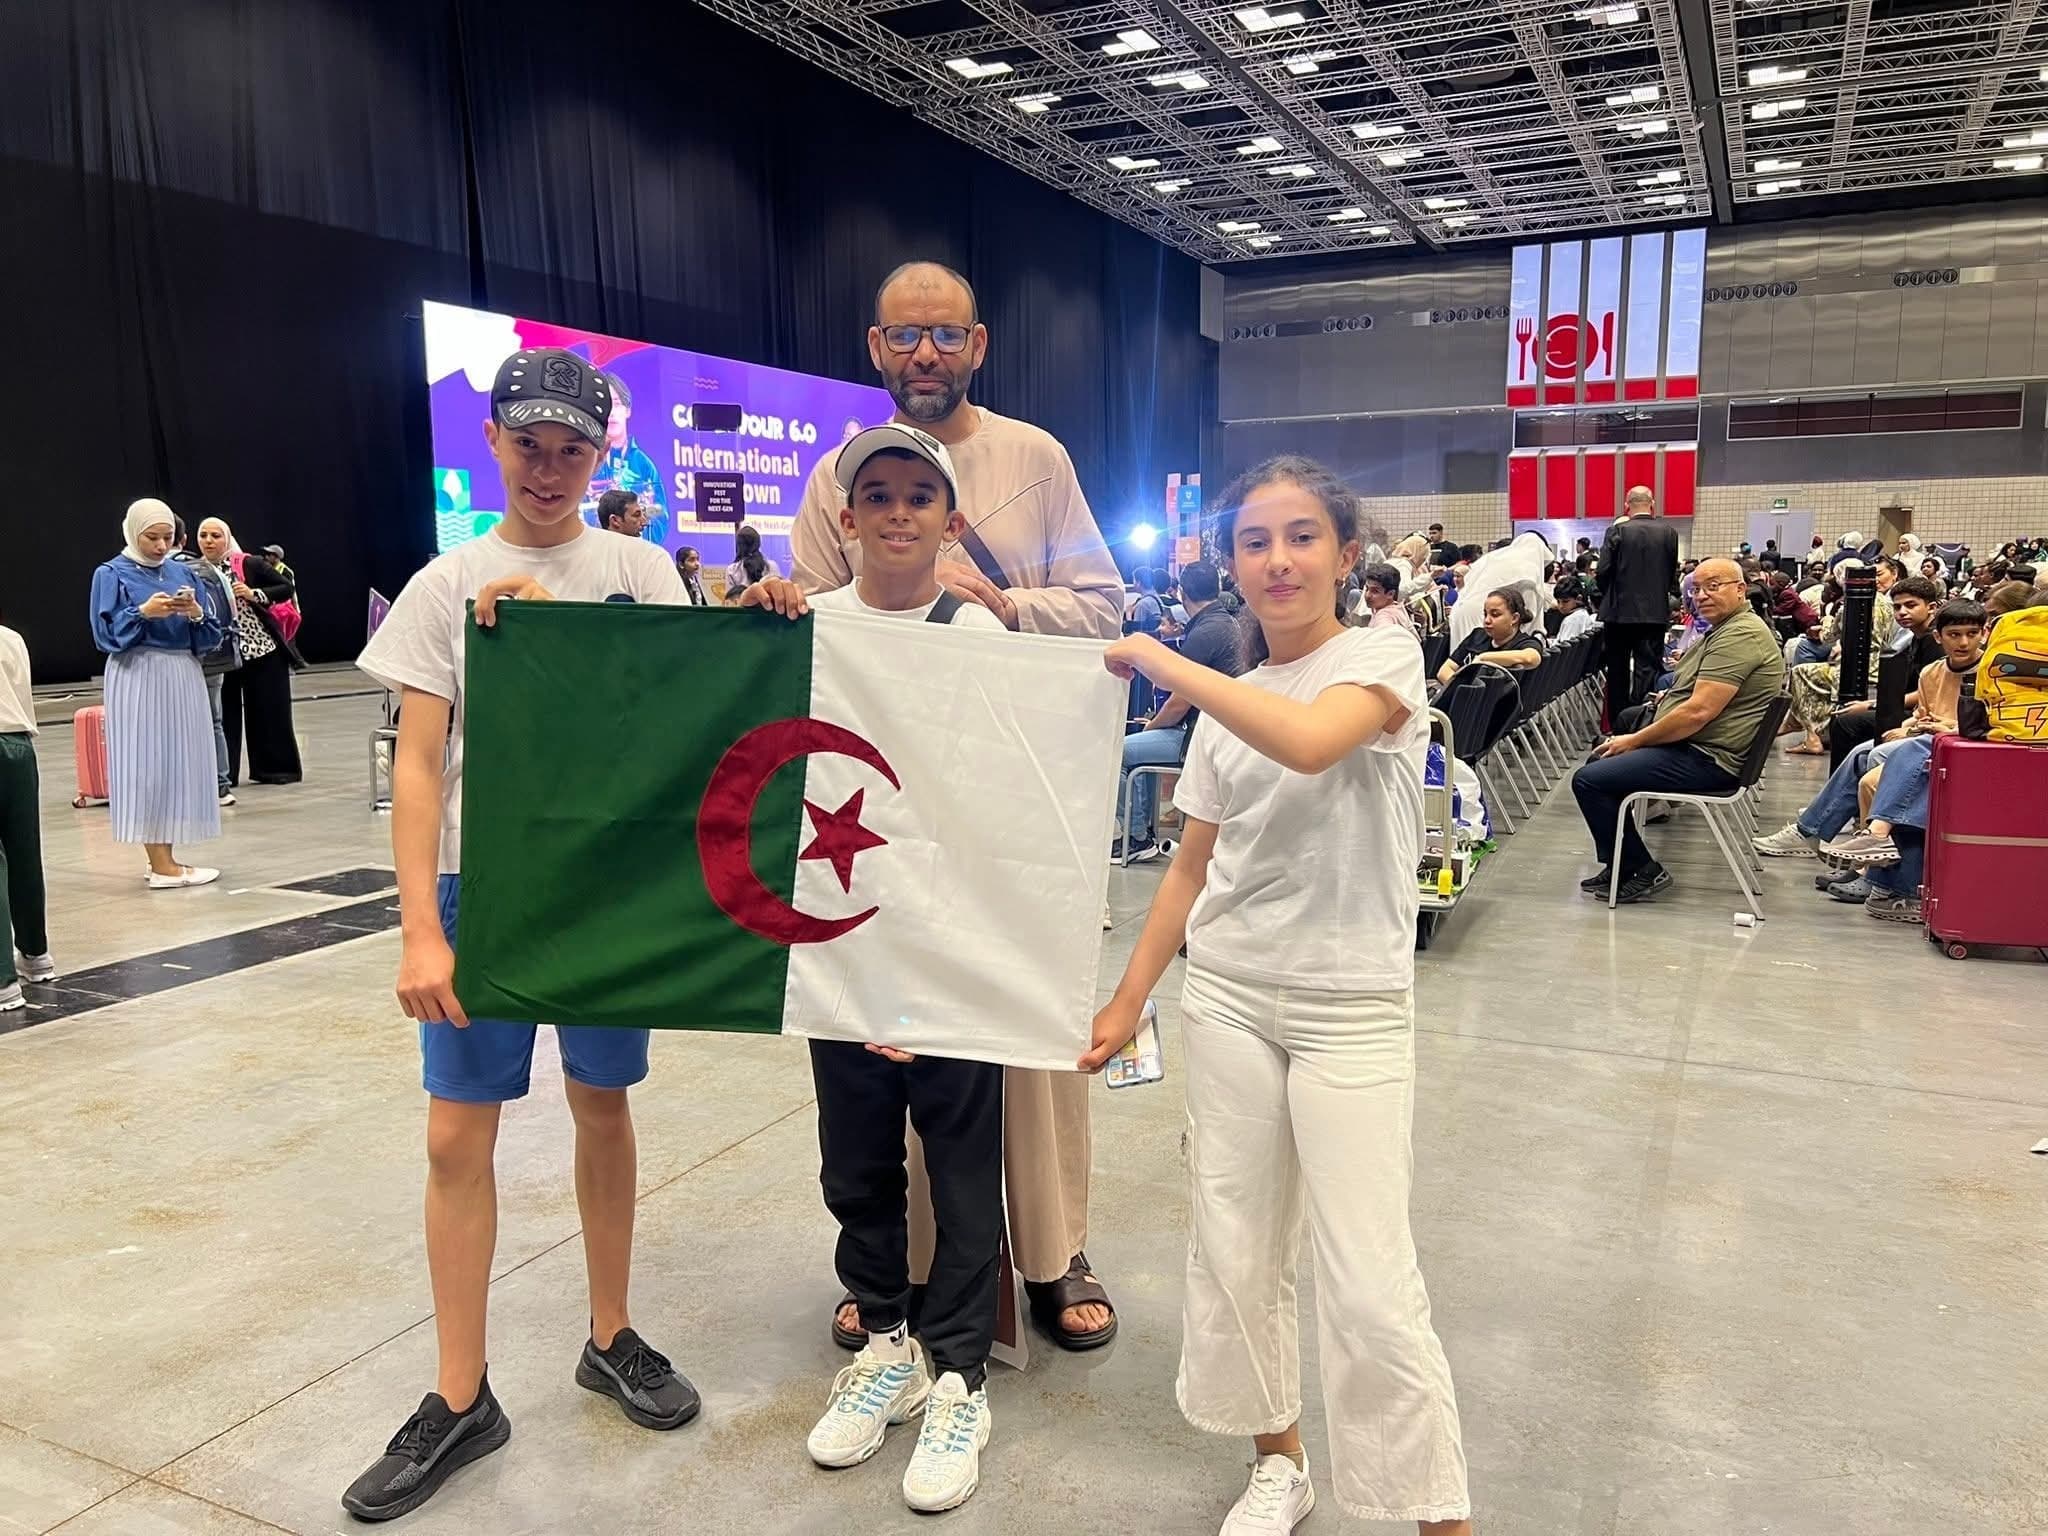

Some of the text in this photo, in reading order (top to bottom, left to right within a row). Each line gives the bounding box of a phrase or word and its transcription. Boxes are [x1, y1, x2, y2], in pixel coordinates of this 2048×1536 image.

[789, 419, 817, 444] 6.0
[674, 438, 800, 477] International
[702, 481, 737, 489] INNOVATION
